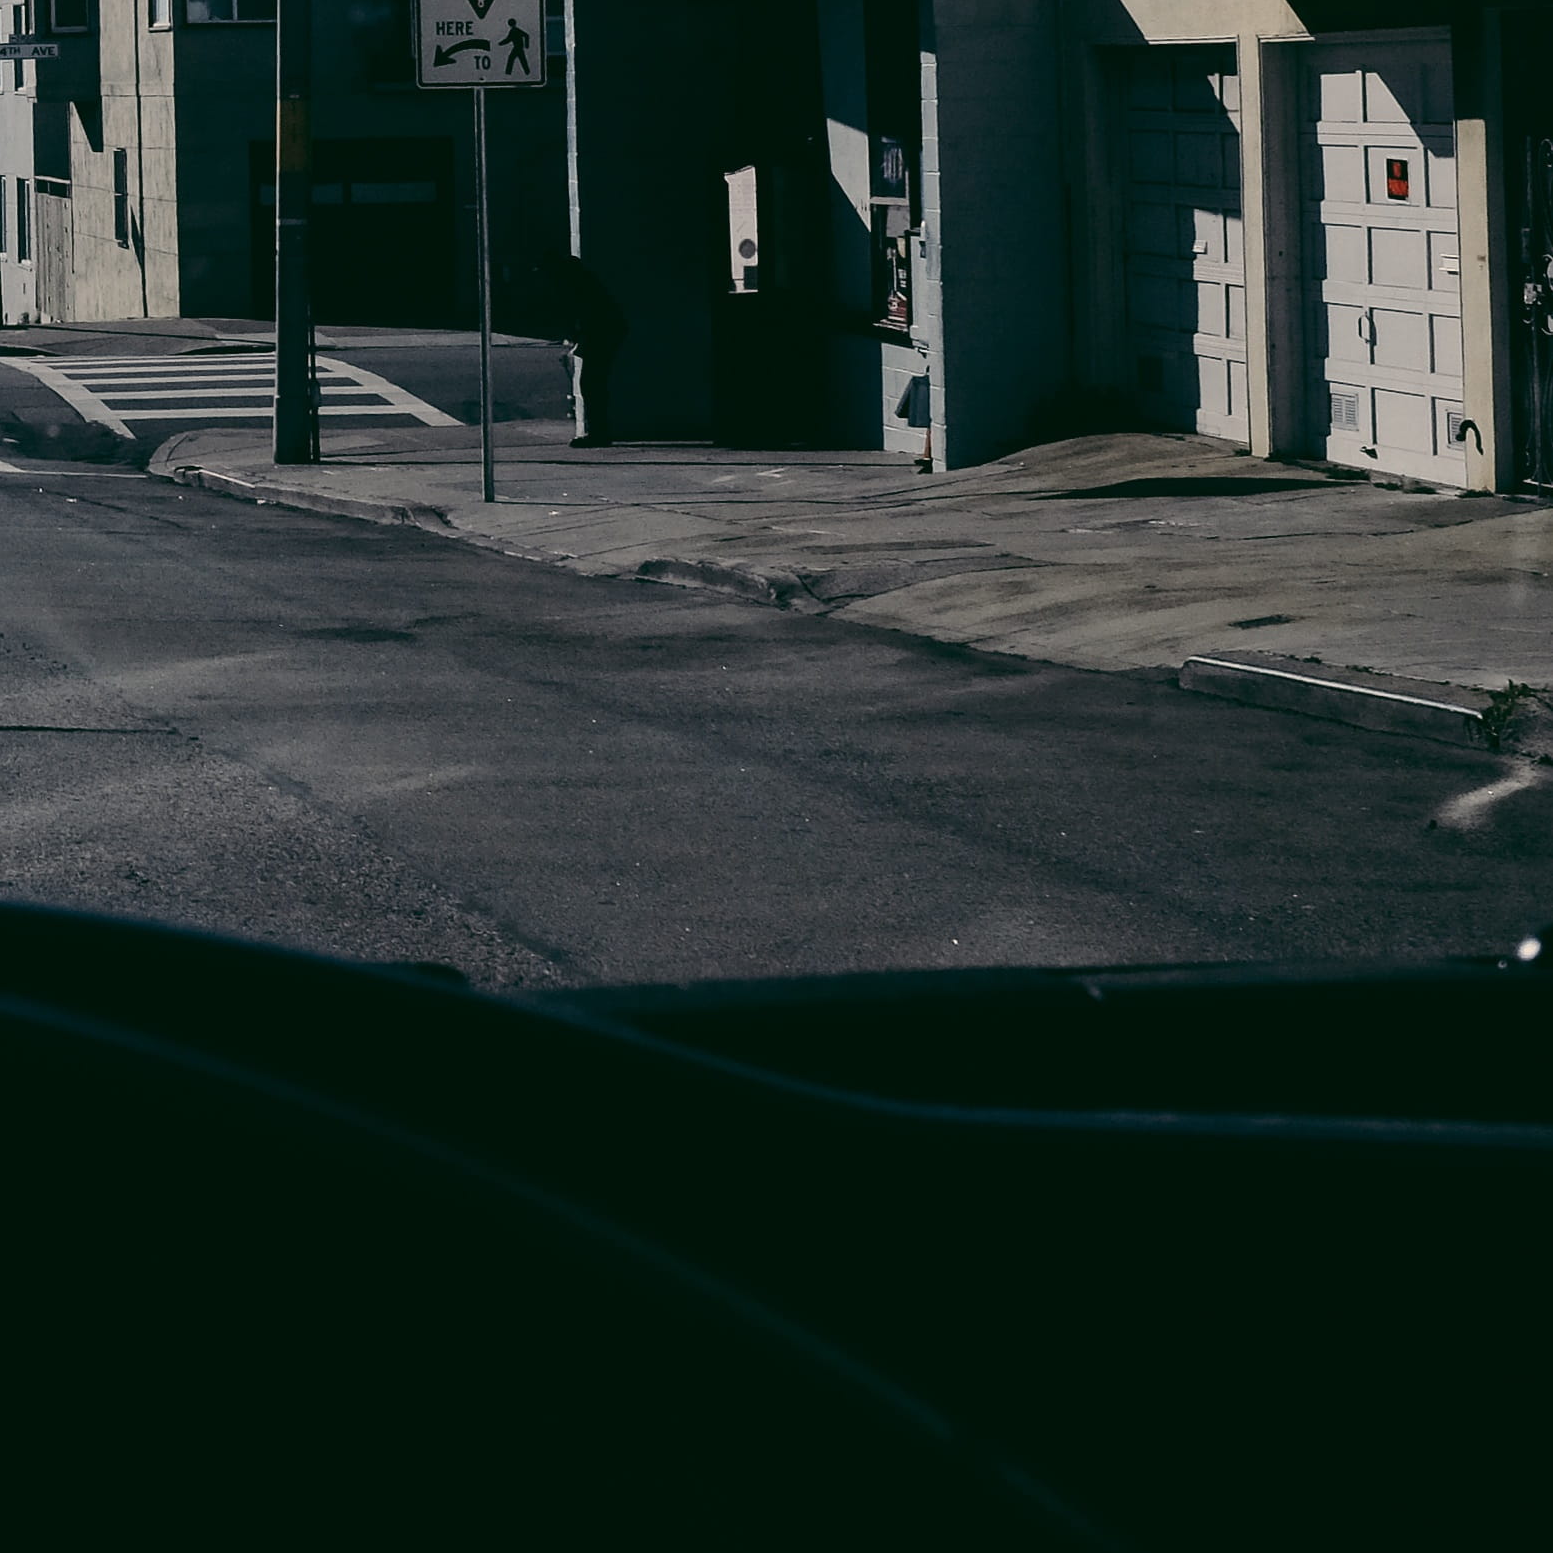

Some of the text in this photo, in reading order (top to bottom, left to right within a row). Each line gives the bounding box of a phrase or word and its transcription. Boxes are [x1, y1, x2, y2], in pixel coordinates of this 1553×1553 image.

[436, 21, 473, 36] HERE
[31, 46, 55, 56] AVE
[473, 56, 491, 70] TO
